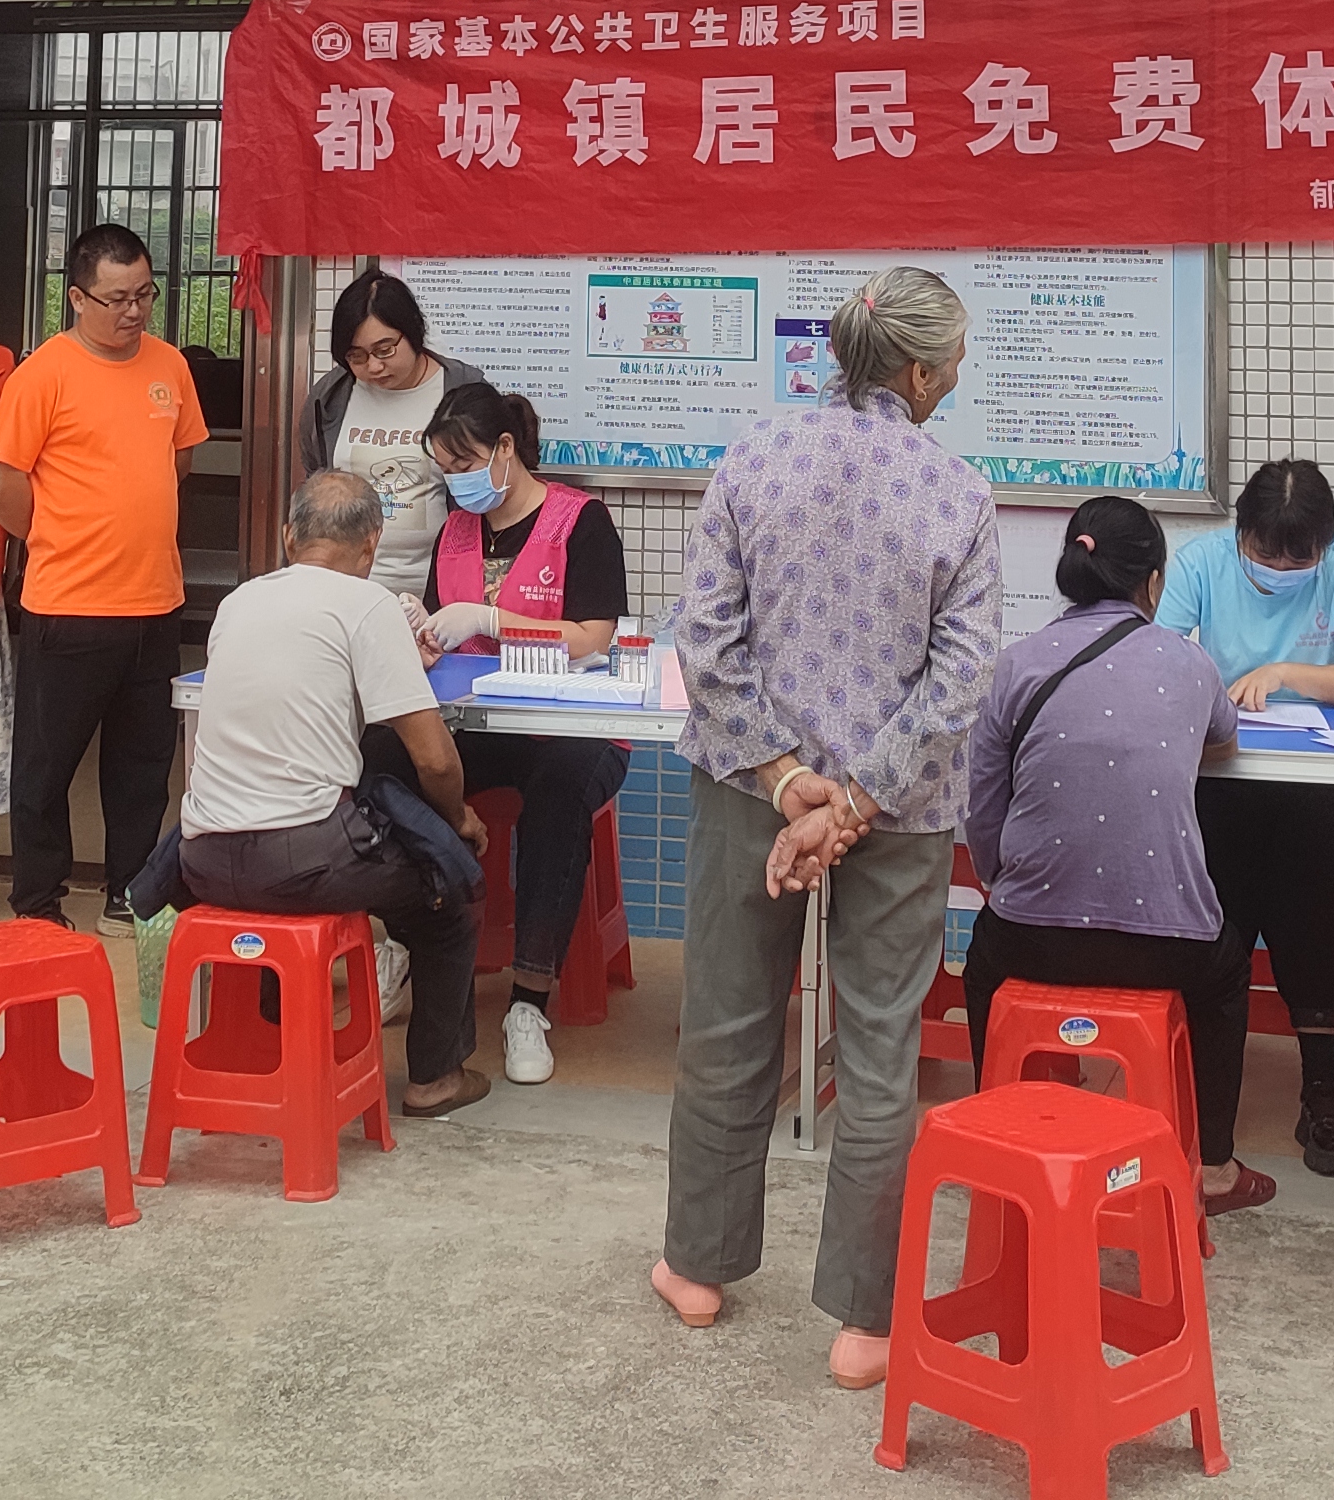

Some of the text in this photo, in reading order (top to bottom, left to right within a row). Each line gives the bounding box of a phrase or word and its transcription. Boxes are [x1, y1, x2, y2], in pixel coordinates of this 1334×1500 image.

[1030, 292, 1106, 307] 健康基本技能
[619, 361, 724, 377] 健康生活方式与行为
[348, 427, 424, 447] PERFEC
